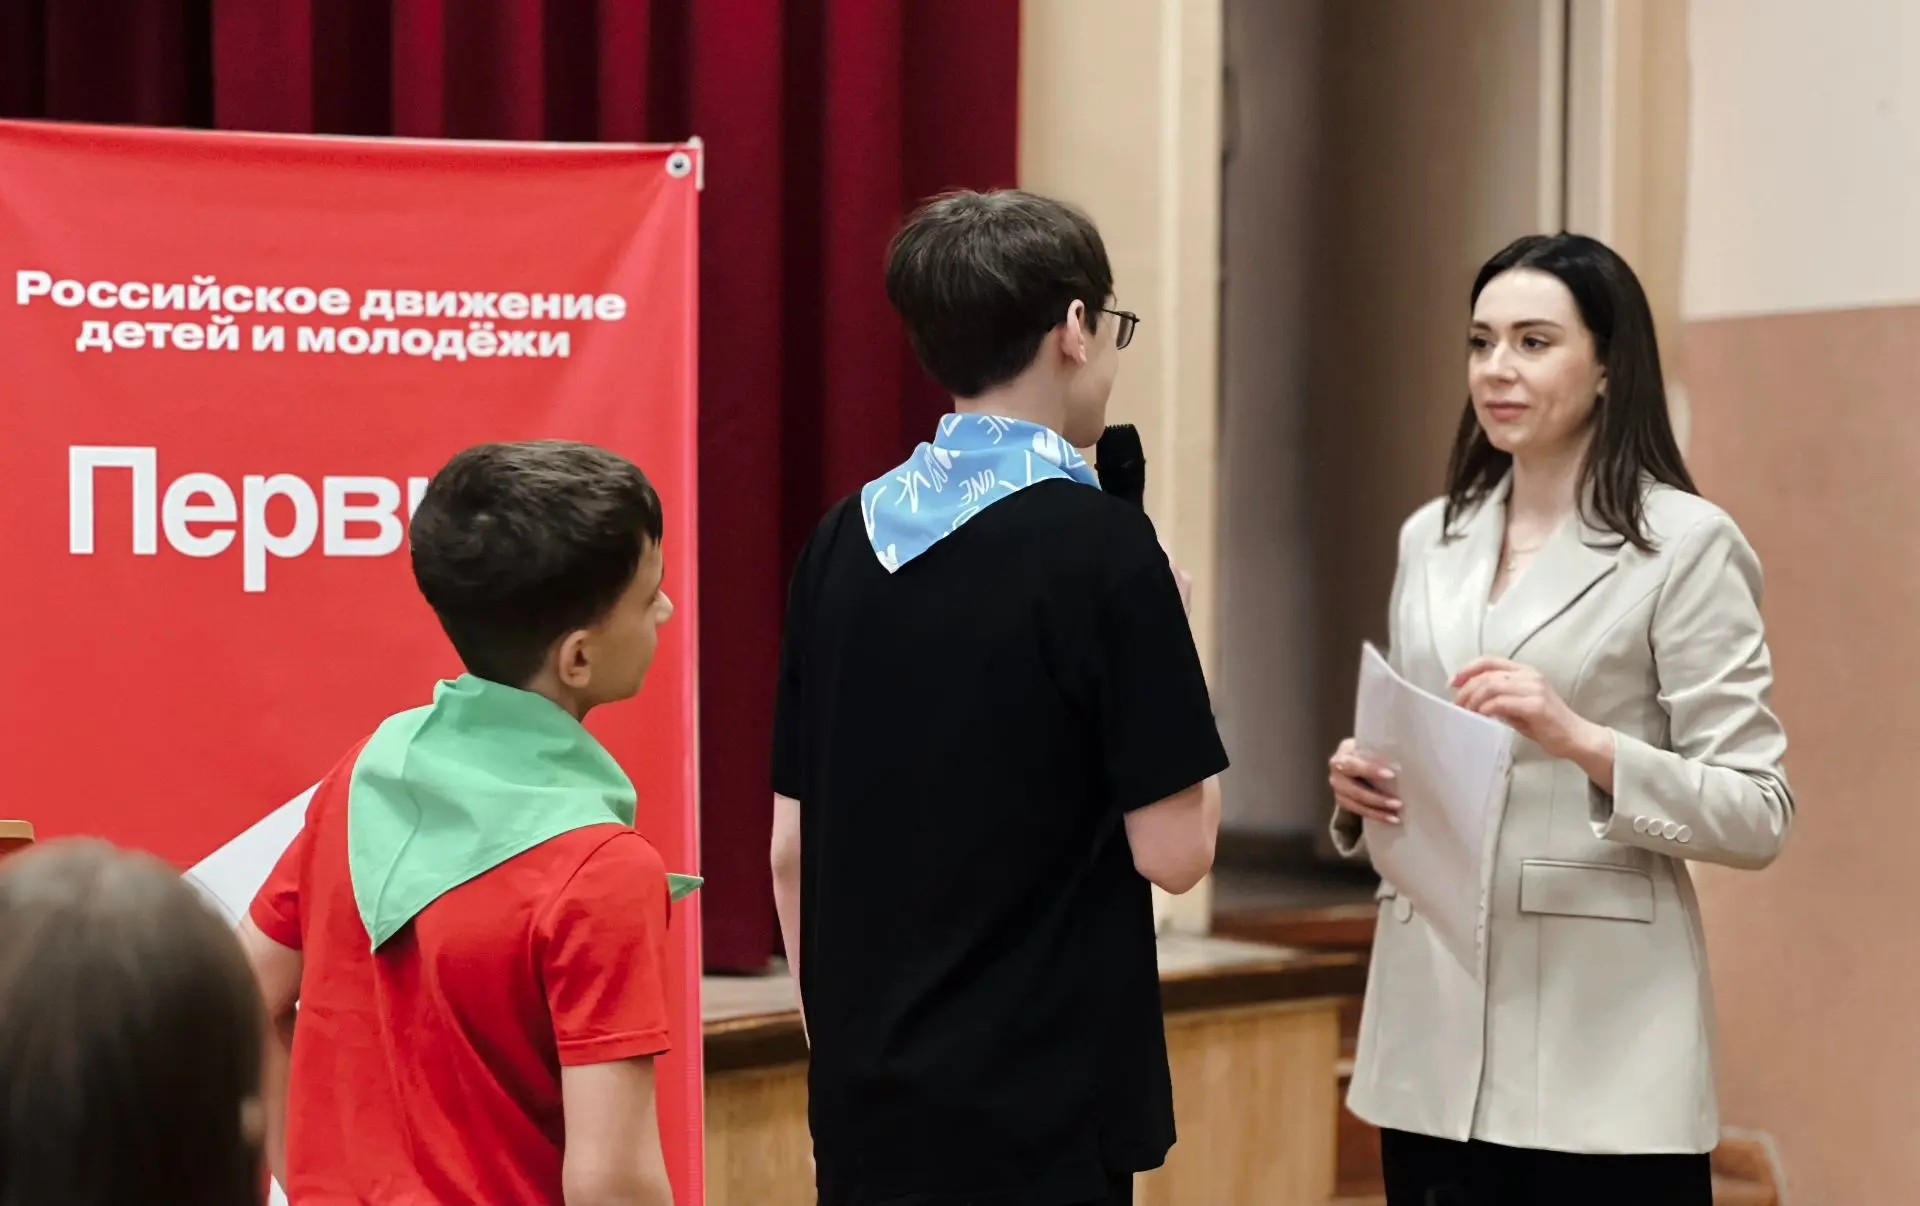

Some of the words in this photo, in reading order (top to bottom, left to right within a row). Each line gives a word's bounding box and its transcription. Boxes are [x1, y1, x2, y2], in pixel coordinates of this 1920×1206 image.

[17, 271, 350, 317] Российское
[360, 288, 627, 322] движение
[76, 319, 239, 354] детей
[253, 325, 285, 353] и
[297, 322, 570, 360] молодёжи
[69, 446, 429, 592] Перв
